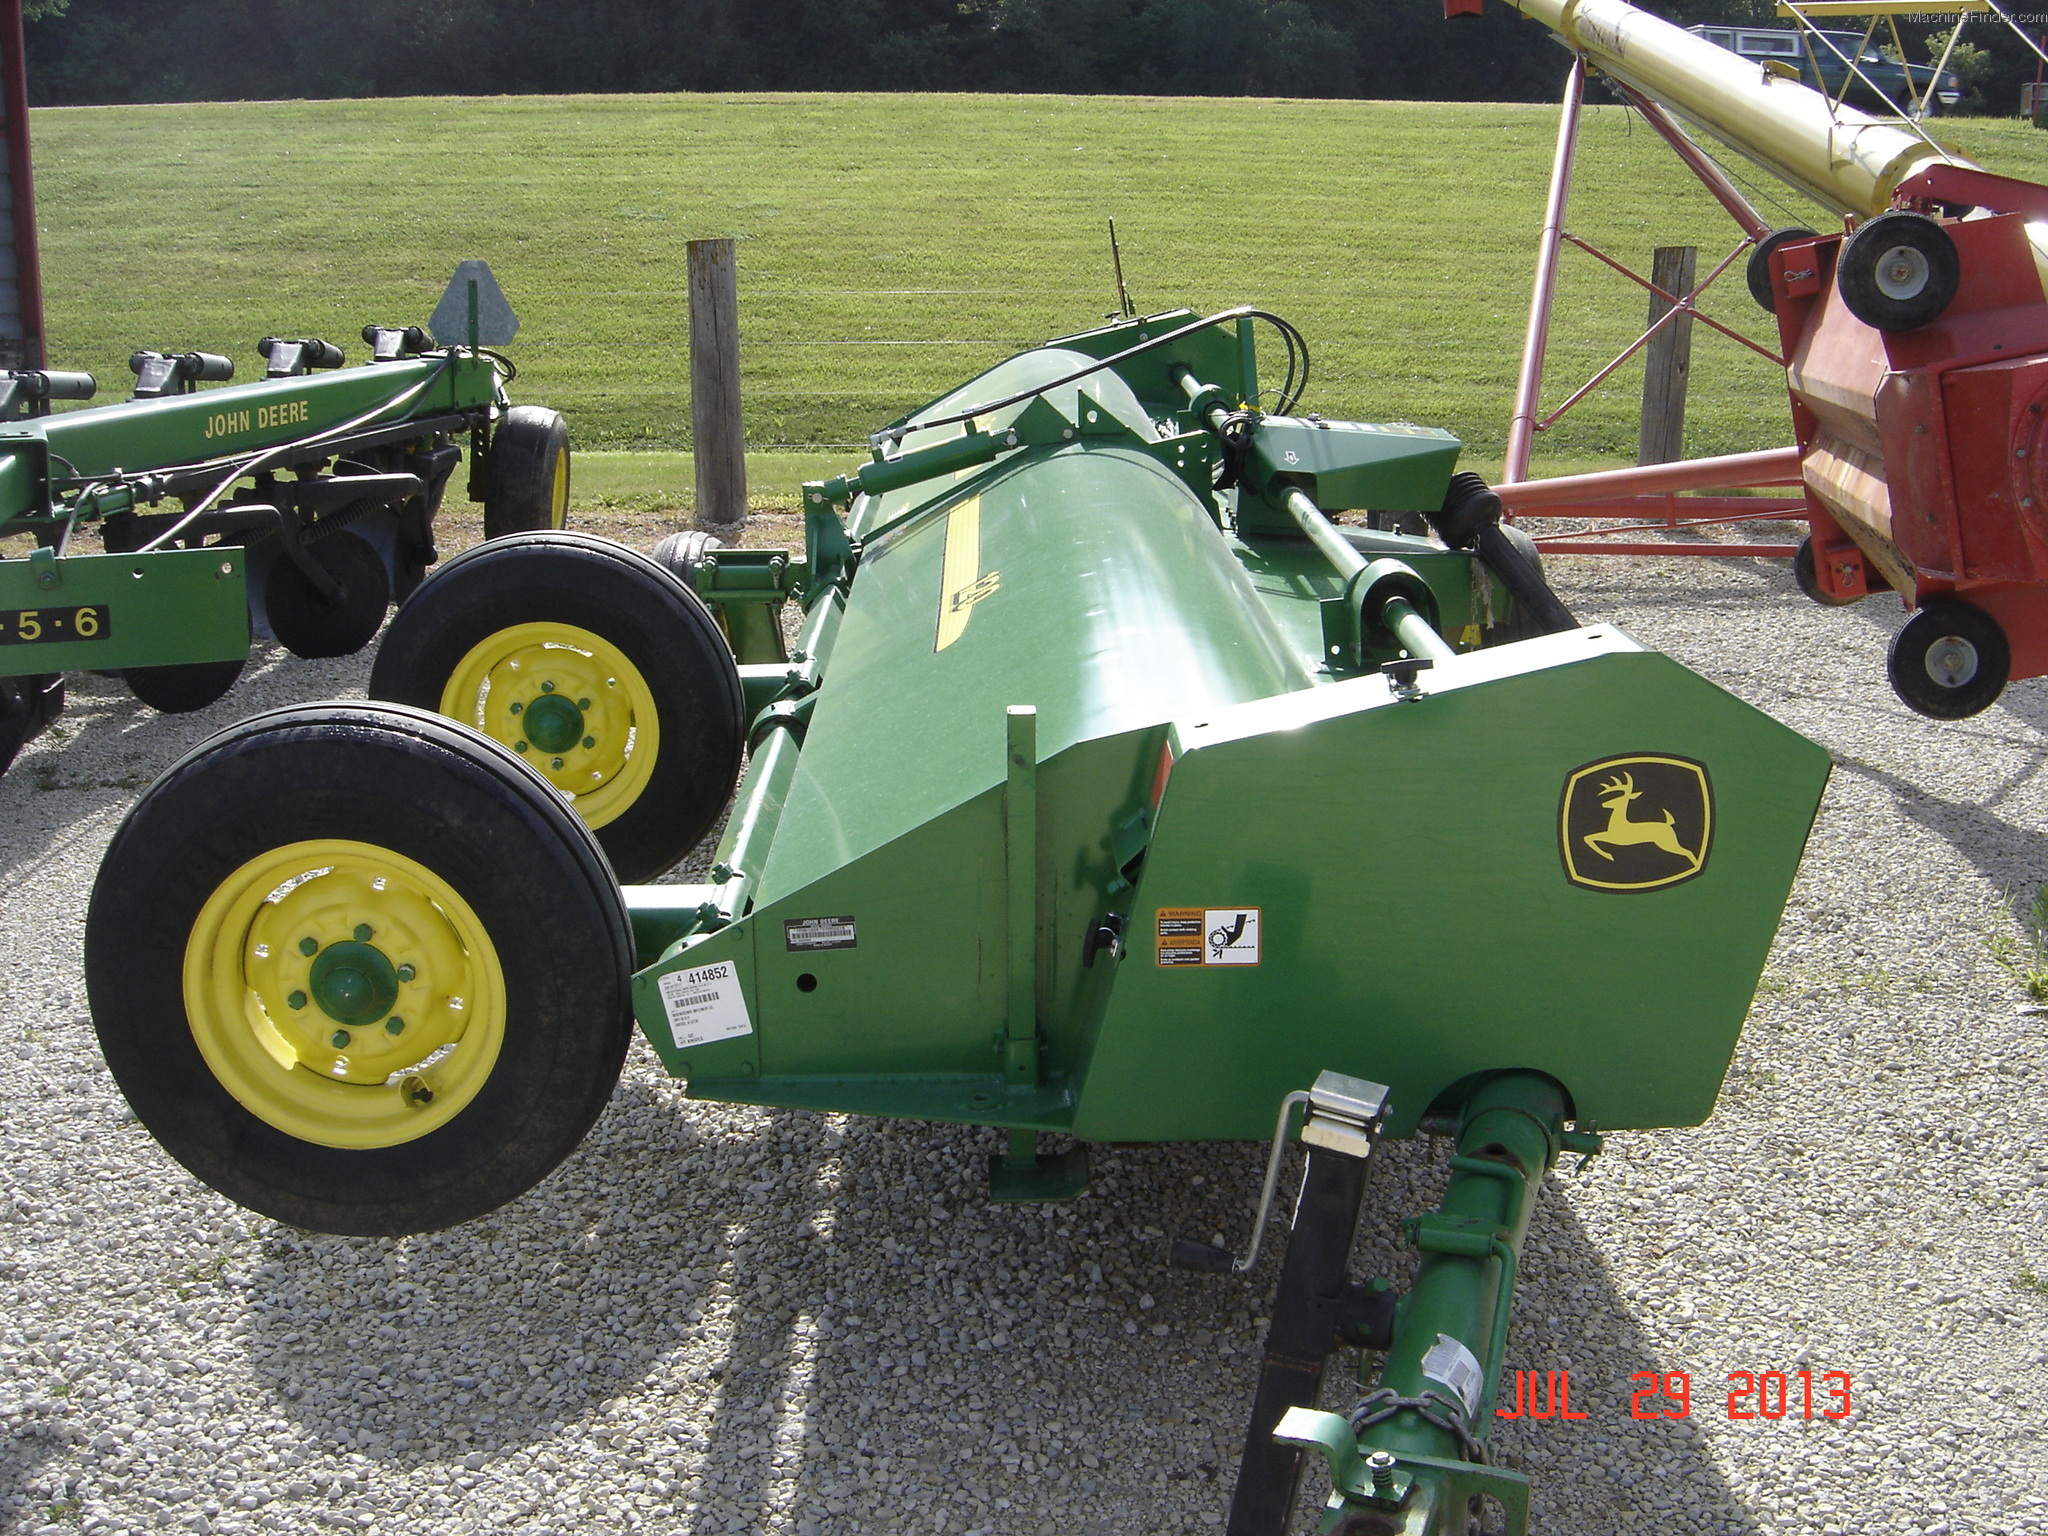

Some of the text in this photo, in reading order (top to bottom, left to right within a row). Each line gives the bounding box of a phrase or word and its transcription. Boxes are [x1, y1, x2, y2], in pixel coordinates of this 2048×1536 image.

[205, 400, 309, 439] JOHN DEERE
[688, 966, 729, 985] 414852
